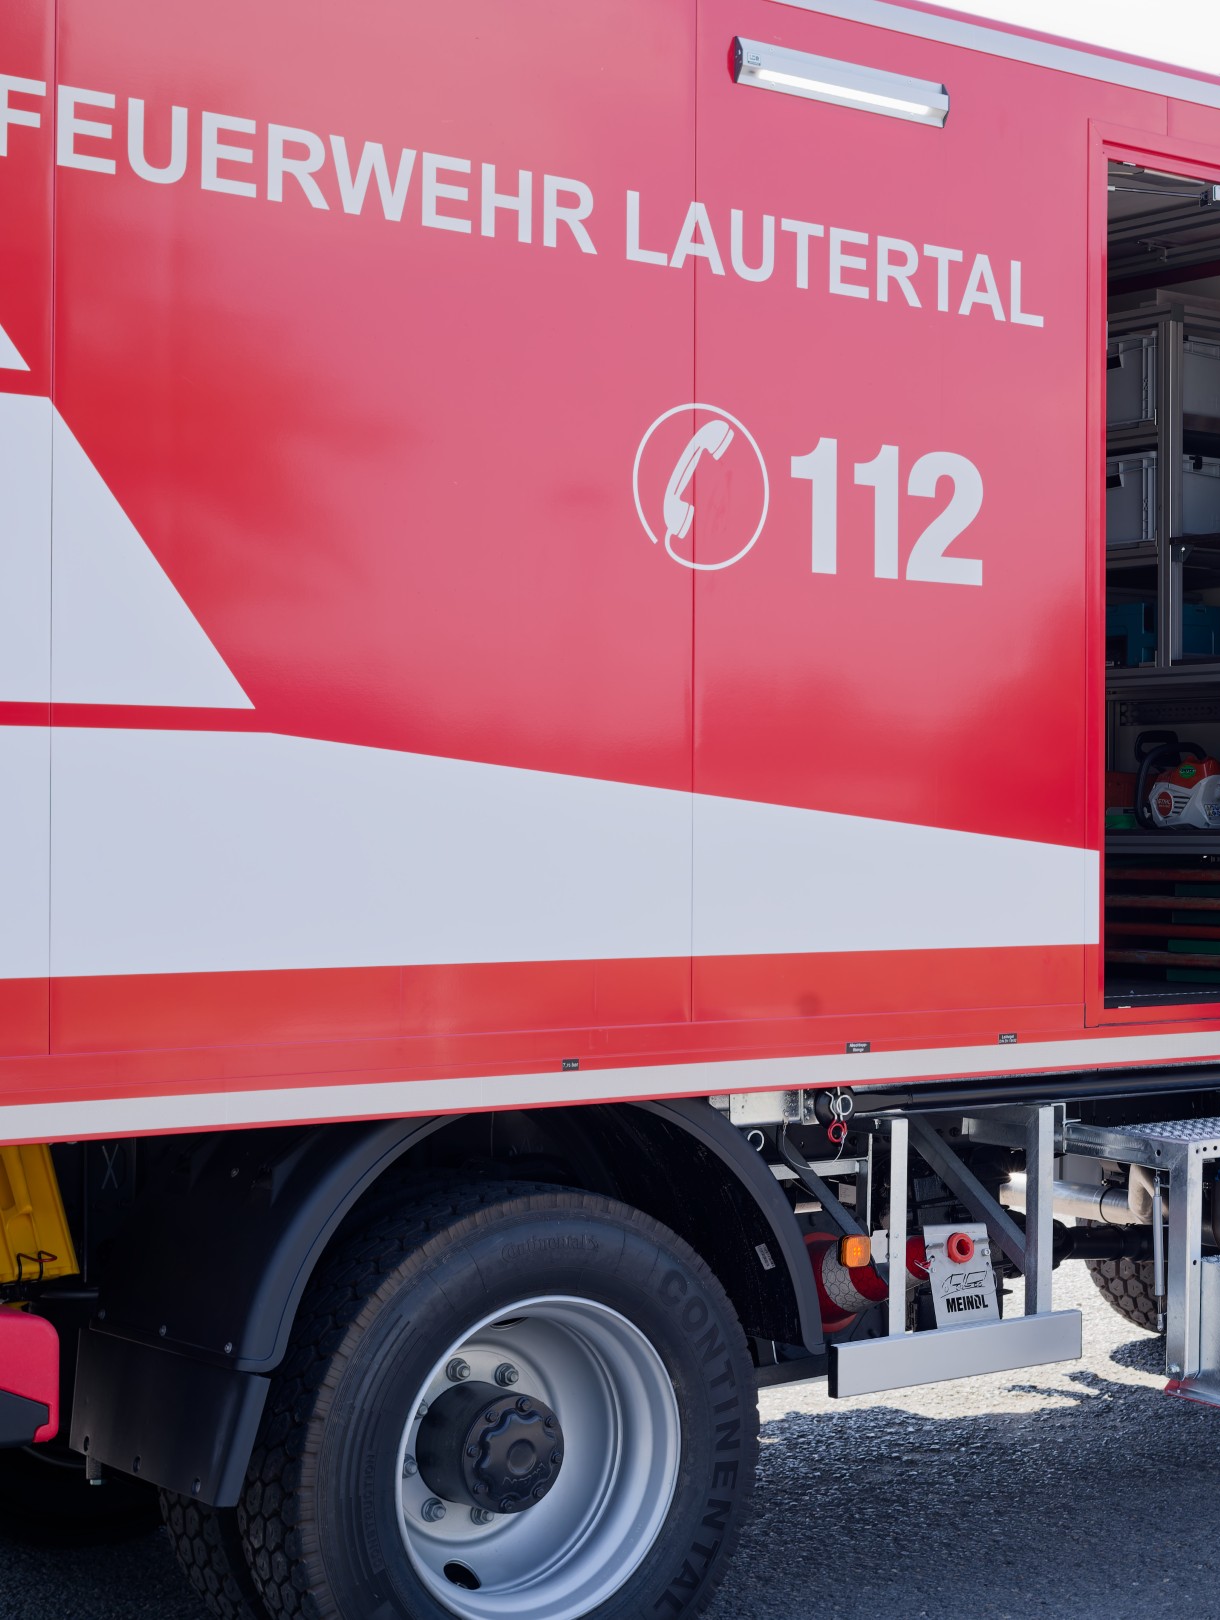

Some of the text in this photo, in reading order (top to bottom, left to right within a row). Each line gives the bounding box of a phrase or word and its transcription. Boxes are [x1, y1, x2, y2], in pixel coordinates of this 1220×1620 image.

[0, 74, 1044, 327] FEUERWEHR LAUTERTAL
[790, 437, 984, 586] 112
[945, 1294, 989, 1313] MEINDL
[652, 1269, 742, 1616] CONTINENTAL
